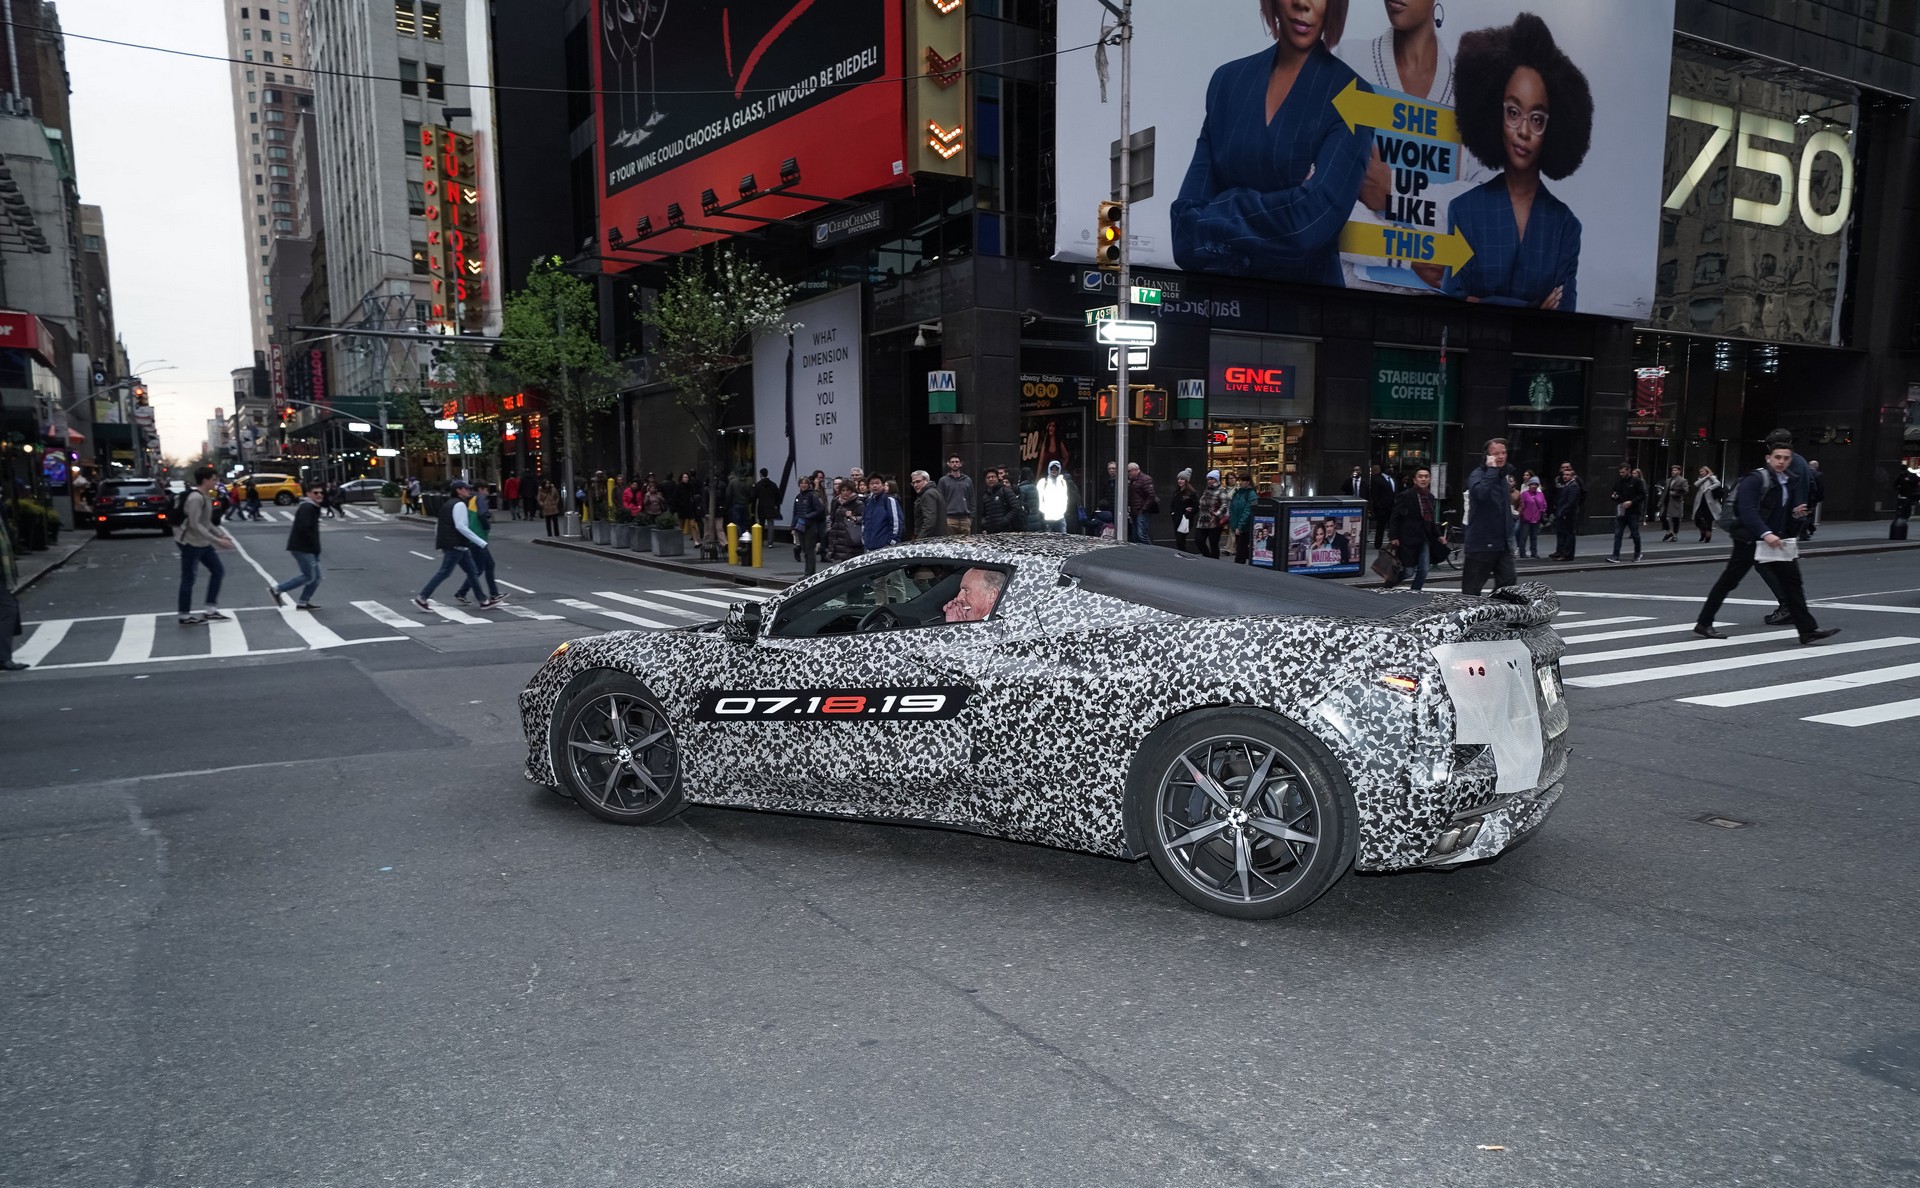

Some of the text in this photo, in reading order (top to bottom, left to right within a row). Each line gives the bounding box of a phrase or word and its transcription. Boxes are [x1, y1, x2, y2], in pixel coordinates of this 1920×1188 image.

[609, 45, 877, 186] IF YOUR WINE COULD CHOOSE A GLASS, IT WOULD BE RIEDEL!
[1392, 102, 1438, 137] SHE
[1376, 134, 1451, 174] WOKE
[1663, 93, 1854, 235] 750
[1395, 167, 1429, 197] UP
[1385, 194, 1437, 227] LIKE
[421, 129, 444, 317] BROOKLYN
[847, 219, 880, 234] SPECTACOLOR
[1383, 228, 1435, 261] THIS
[1141, 290, 1148, 302] 7
[1086, 311, 1093, 325] W
[1095, 309, 1105, 320] 49
[813, 328, 837, 346] WHAT
[802, 346, 849, 368] DIMENSION
[272, 348, 283, 394] Park
[817, 370, 834, 385] ARE
[1020, 374, 1064, 383] ubway Station
[1225, 366, 1283, 385] GNC
[1225, 383, 1282, 393] LIVE WELL
[1391, 385, 1435, 400] COFFEE
[817, 391, 834, 405] YOU
[815, 411, 837, 426] EVEN
[820, 432, 833, 445] IN?
[714, 694, 947, 714] 07.18.19
